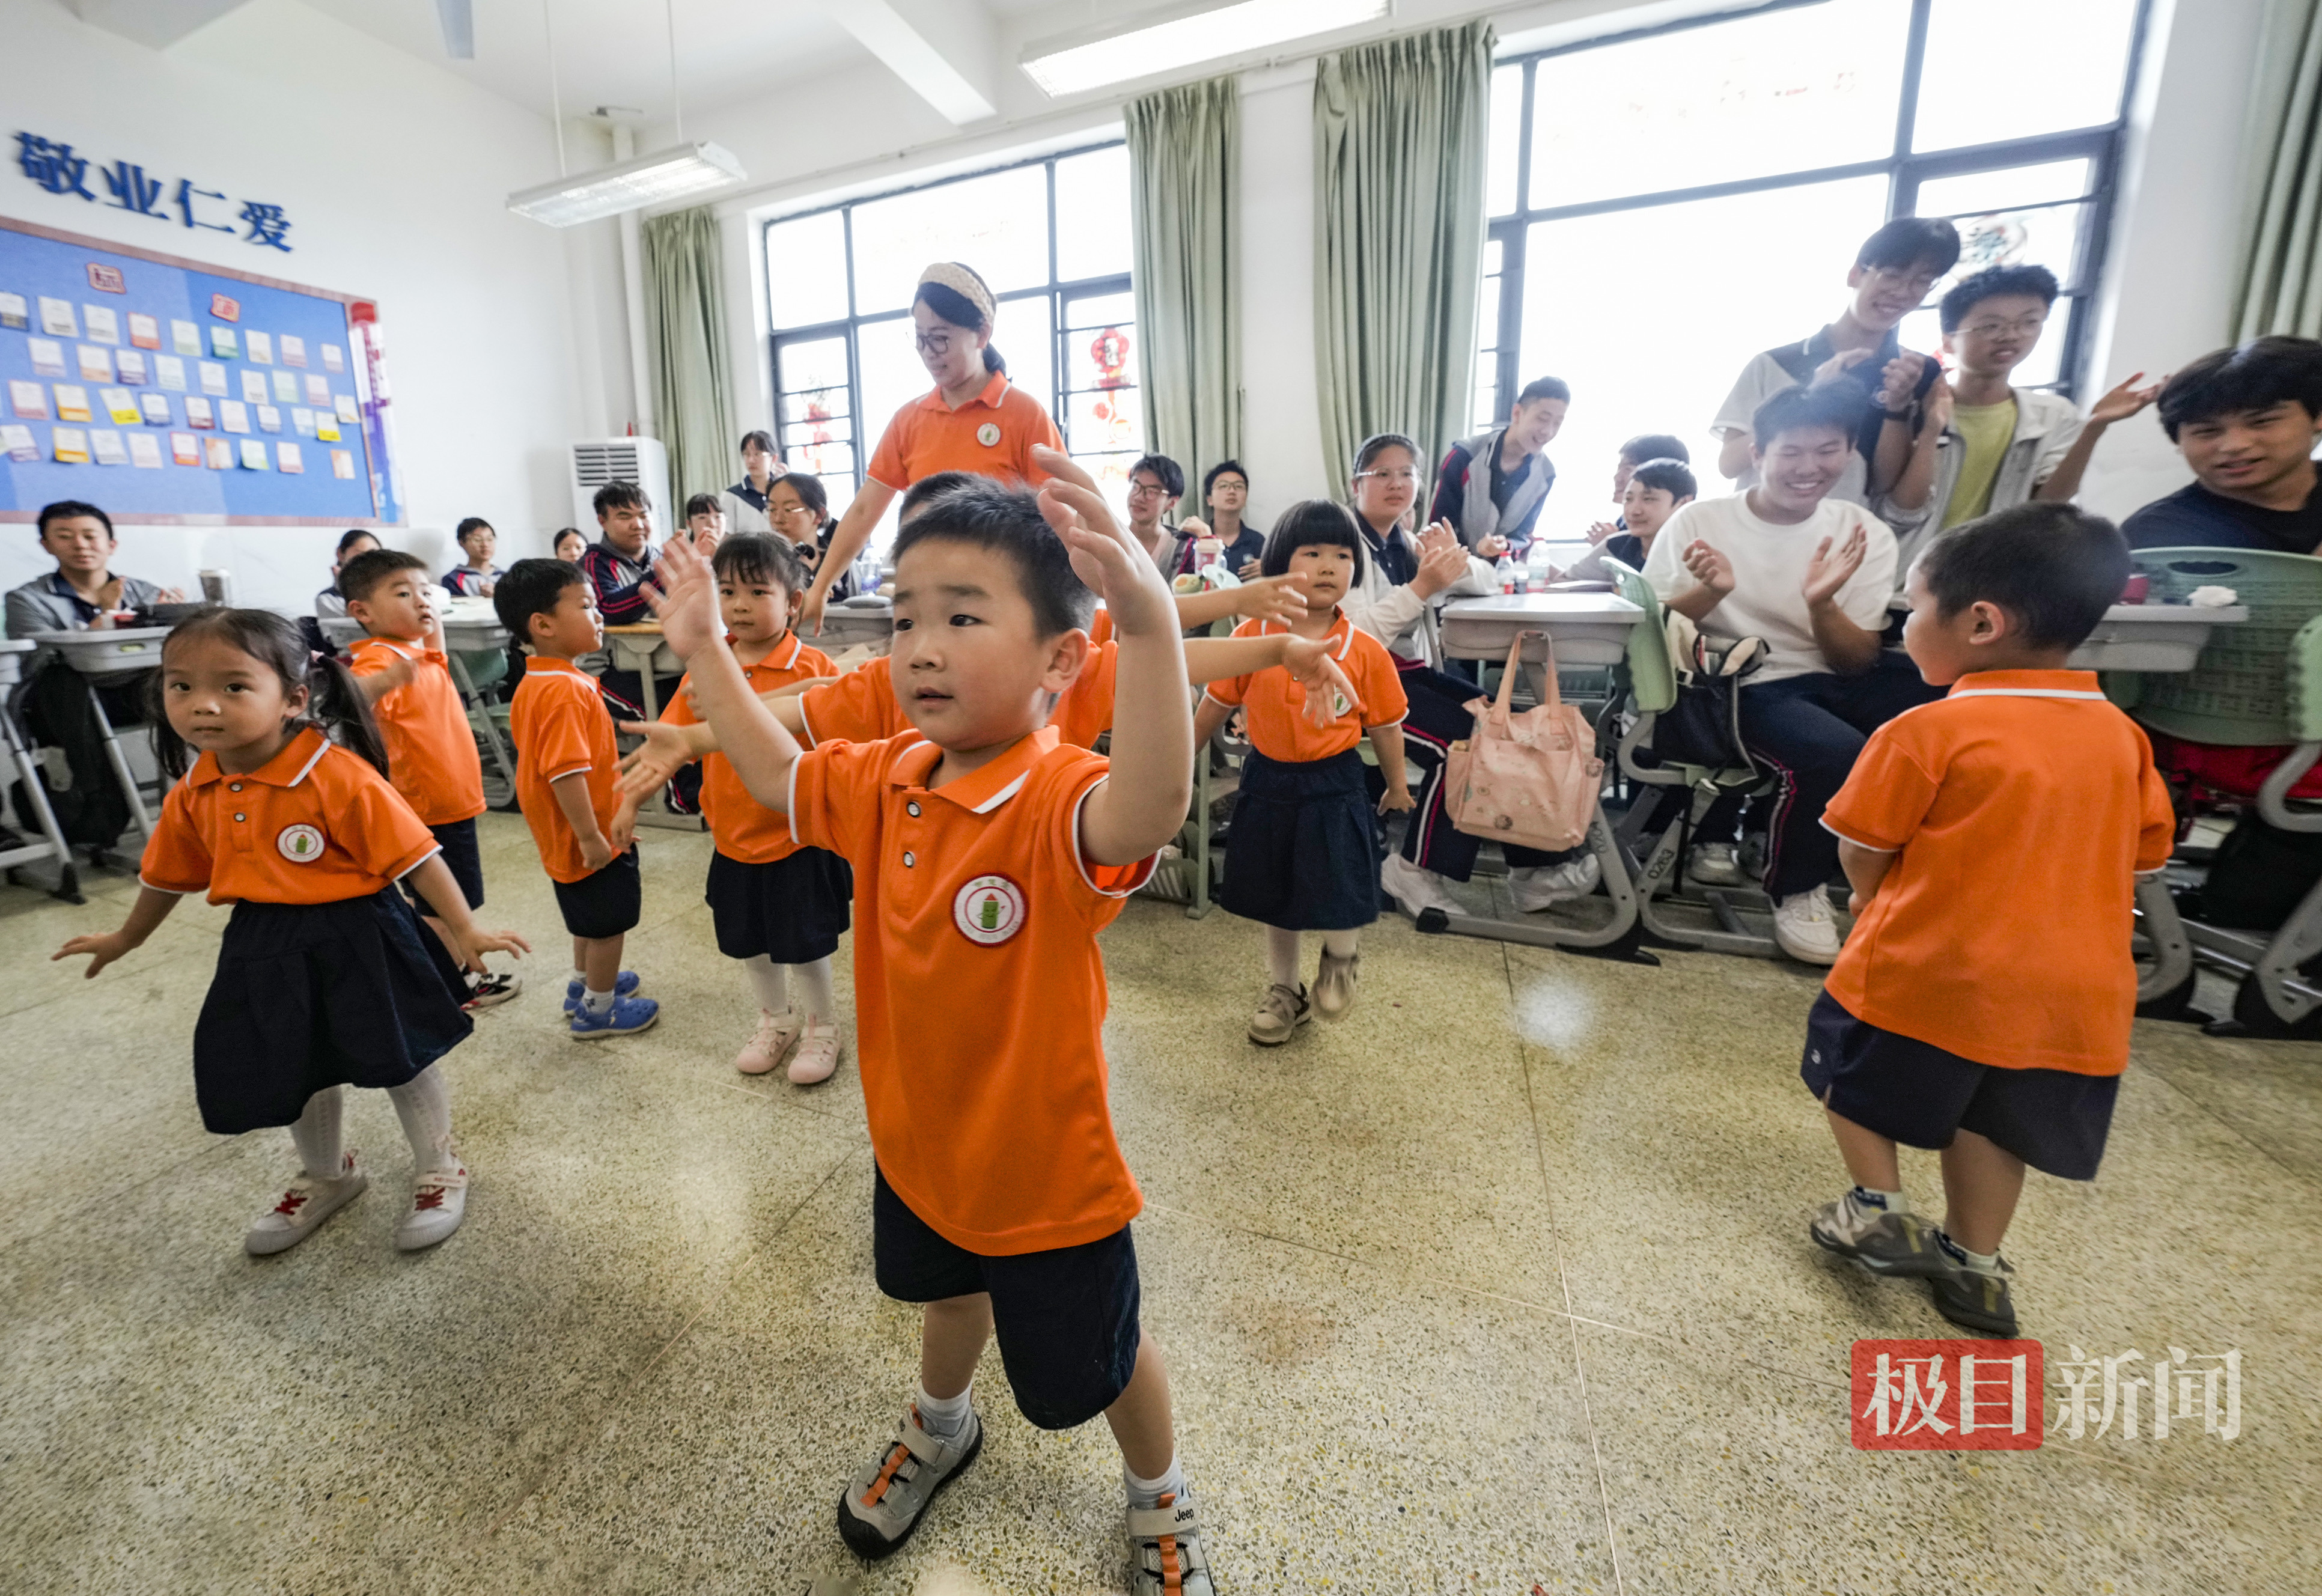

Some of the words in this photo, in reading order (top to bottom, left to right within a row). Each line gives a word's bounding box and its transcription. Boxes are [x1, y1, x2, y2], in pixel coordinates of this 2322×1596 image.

[11, 131, 293, 252] 敬业仁爱
[1174, 1508, 1194, 1522] Jeep
